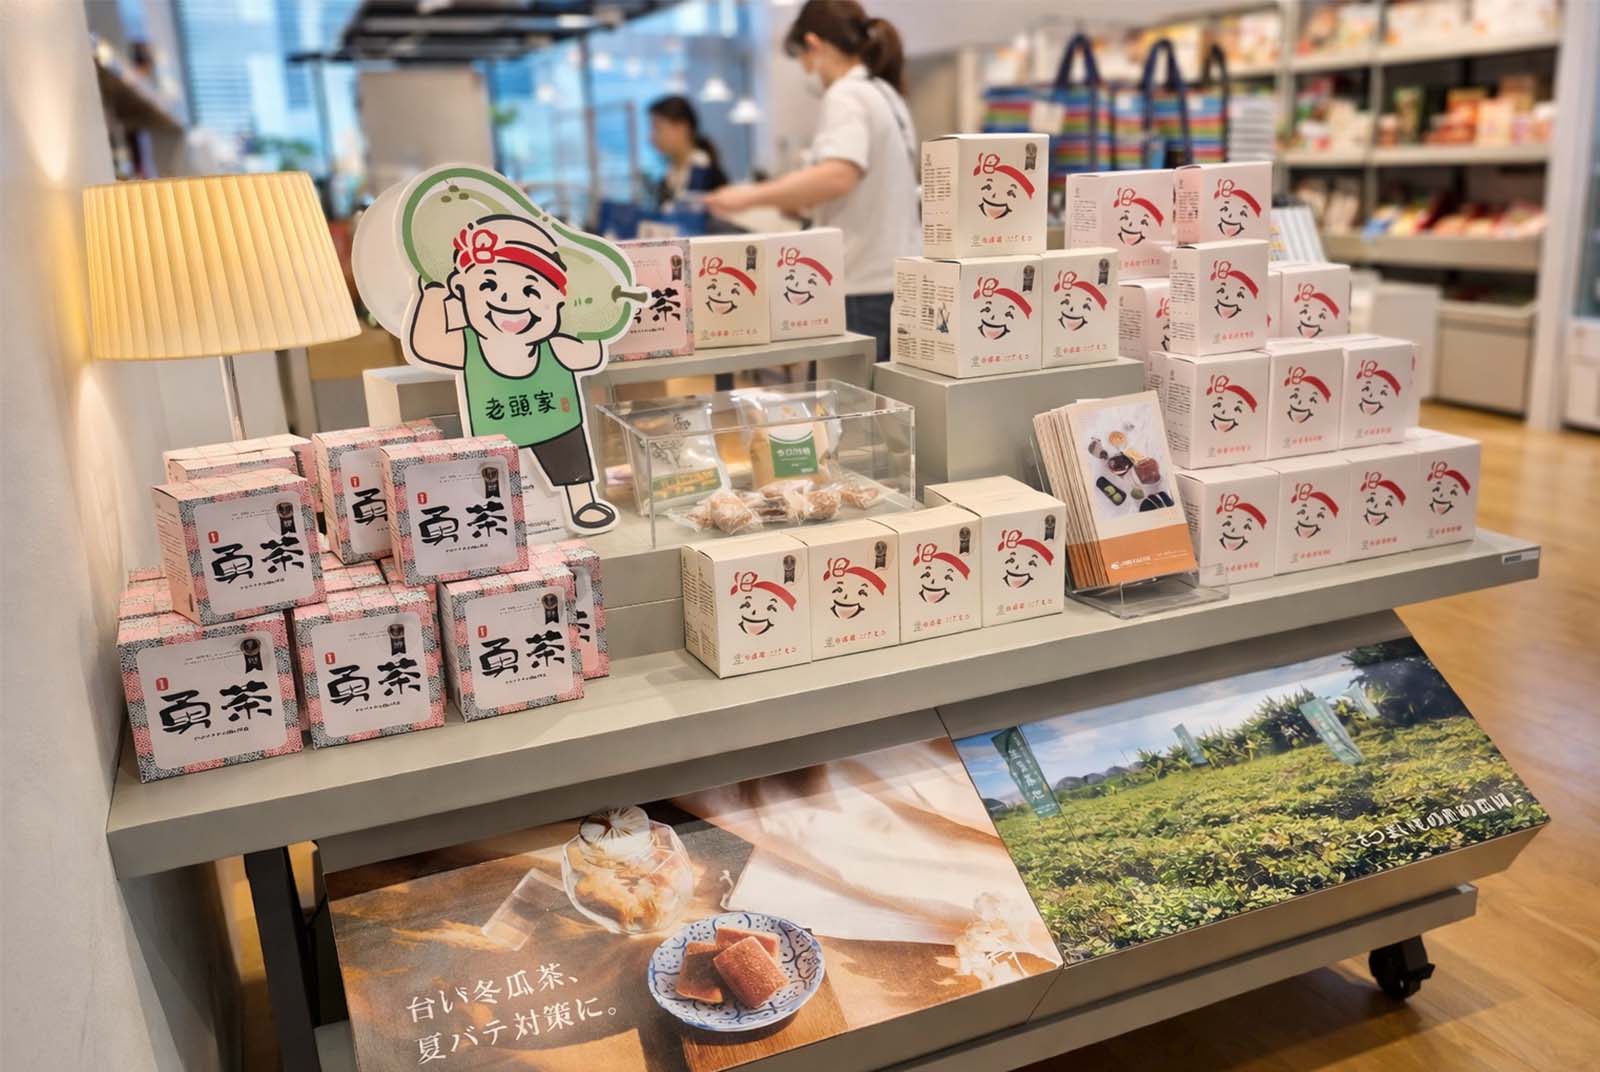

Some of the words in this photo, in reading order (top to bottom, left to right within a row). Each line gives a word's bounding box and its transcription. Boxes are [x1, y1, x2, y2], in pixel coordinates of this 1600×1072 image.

[485, 390, 558, 421] 老頭家
[415, 996, 619, 1066] 夏バテ対策に。
